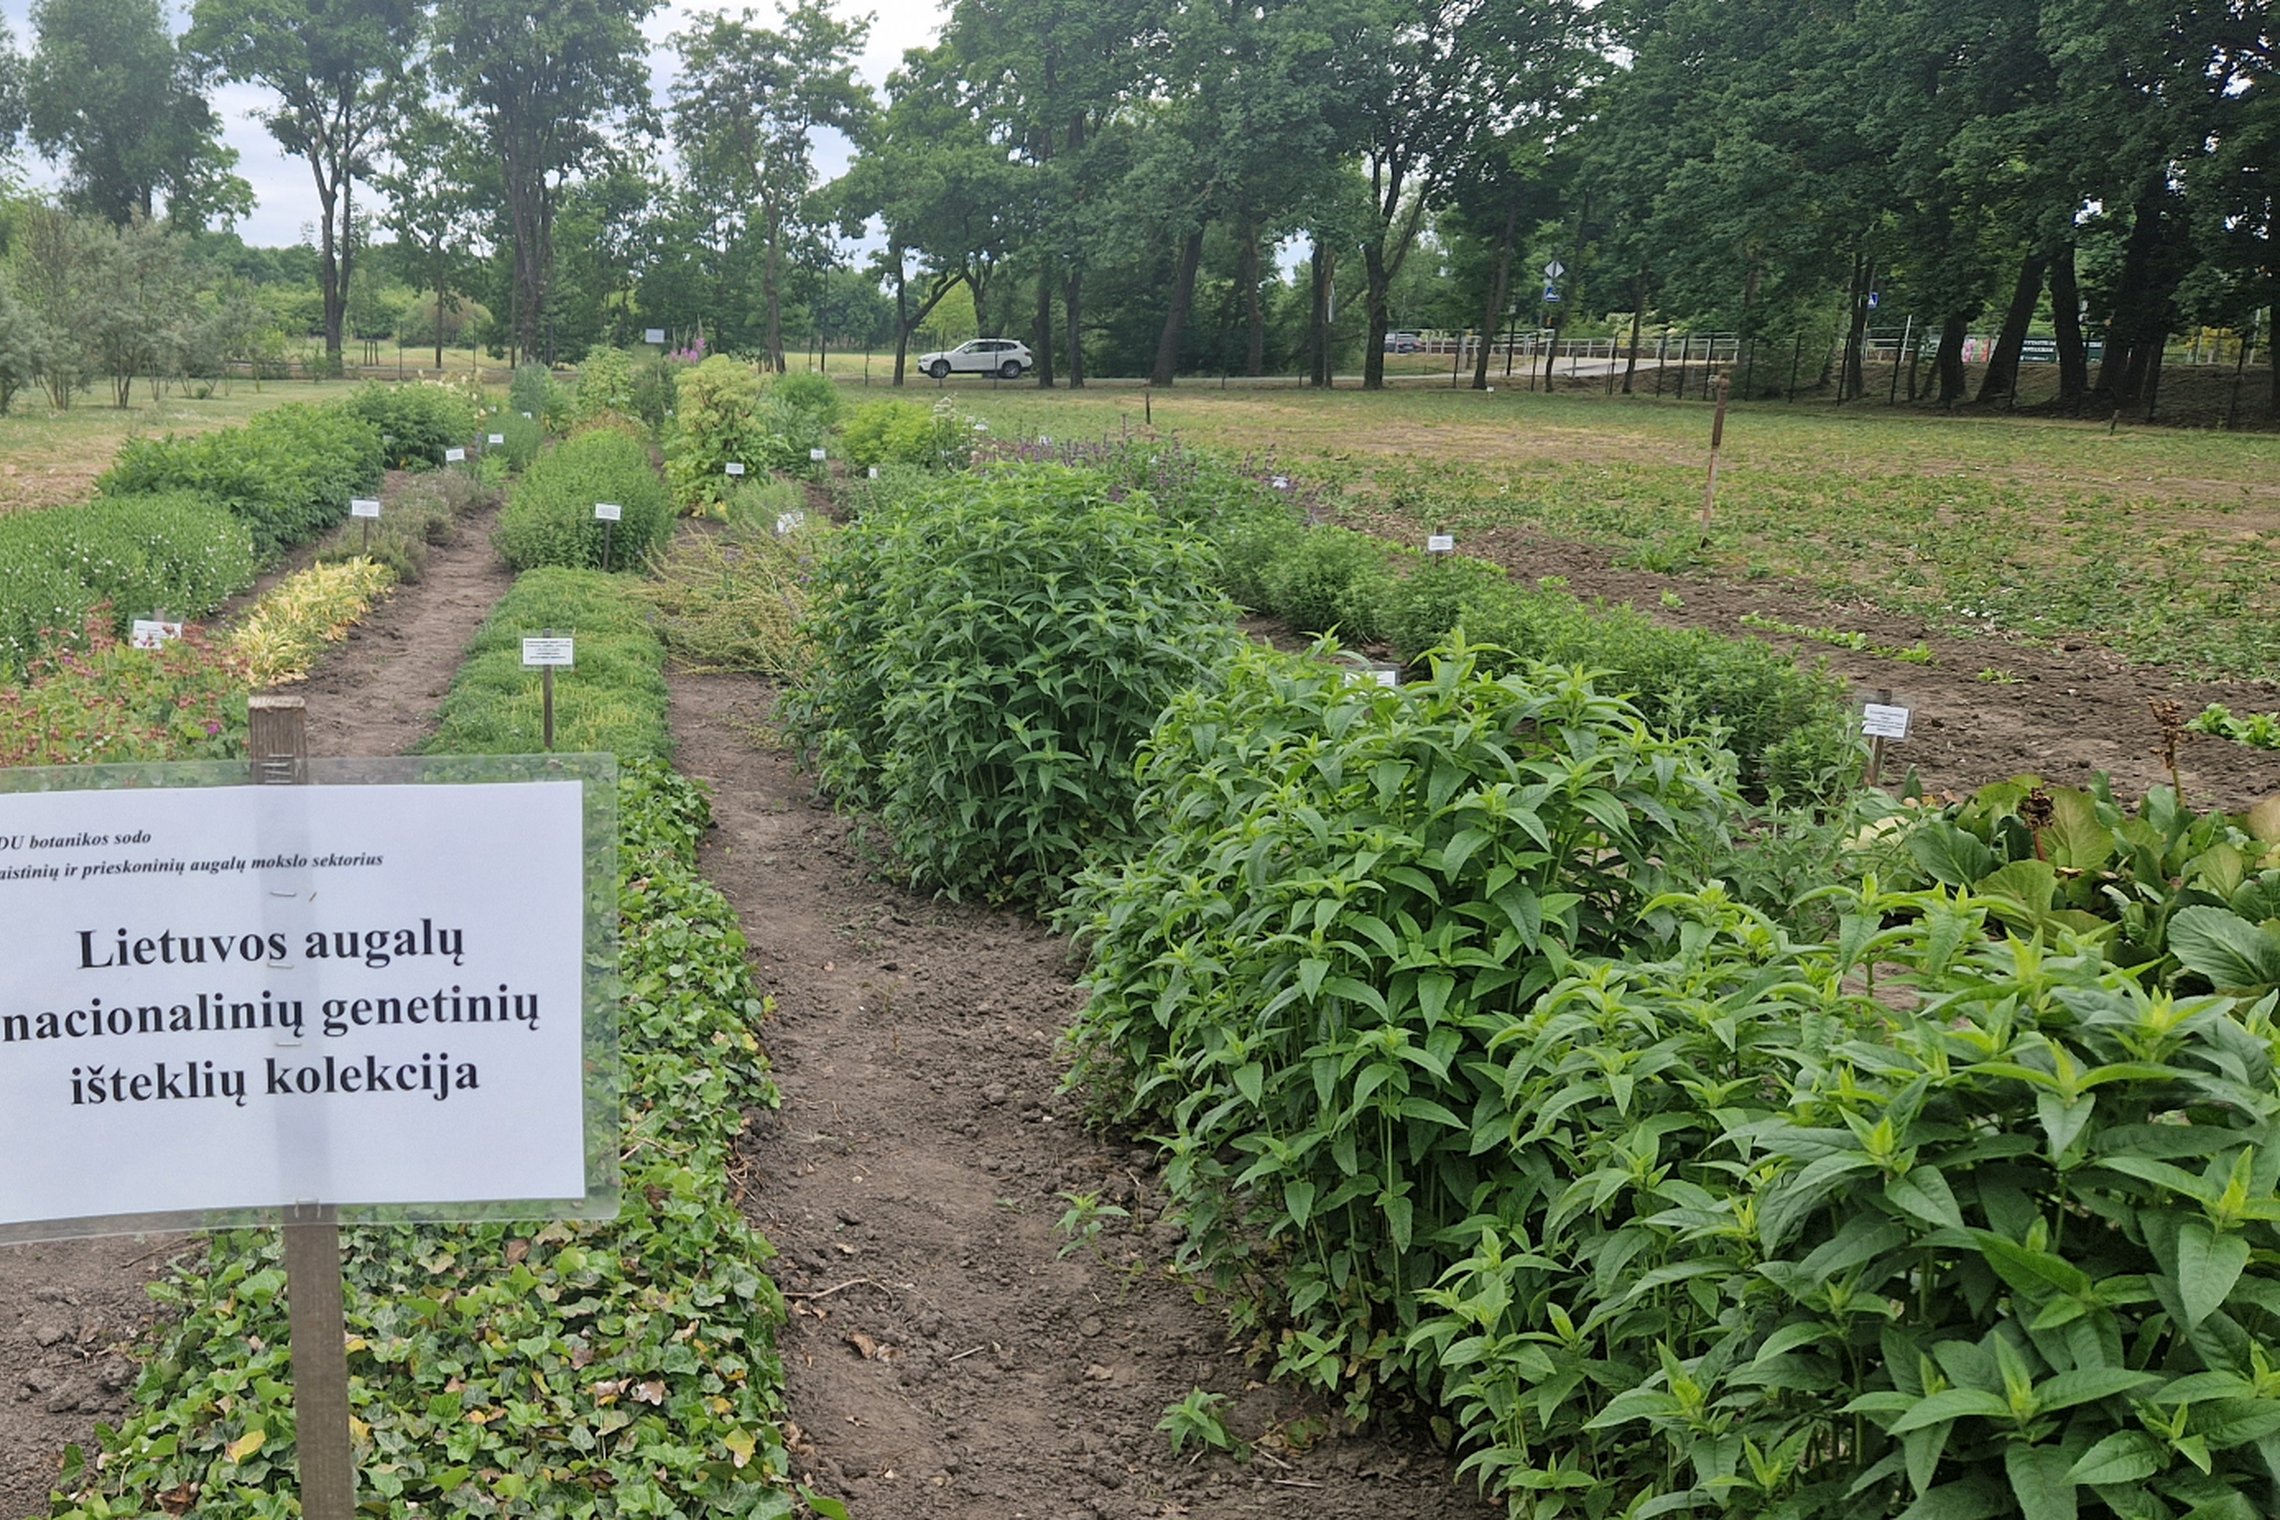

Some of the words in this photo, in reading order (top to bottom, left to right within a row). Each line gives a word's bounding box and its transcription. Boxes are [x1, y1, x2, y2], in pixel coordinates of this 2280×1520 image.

[29, 832, 109, 850] botanikos
[113, 830, 152, 845] sodo
[64, 862, 79, 877] ir
[81, 858, 186, 880] prieskoninių
[189, 856, 247, 874] augalų
[250, 854, 308, 870] mokslo
[311, 852, 384, 868] sektorius
[76, 927, 288, 969] Lietuvos
[305, 918, 466, 969] augalų
[2, 990, 304, 1041] nacionalinių
[322, 984, 540, 1037] genetinių
[70, 1060, 247, 1107] išteklių
[264, 1052, 480, 1101] kolekcija
